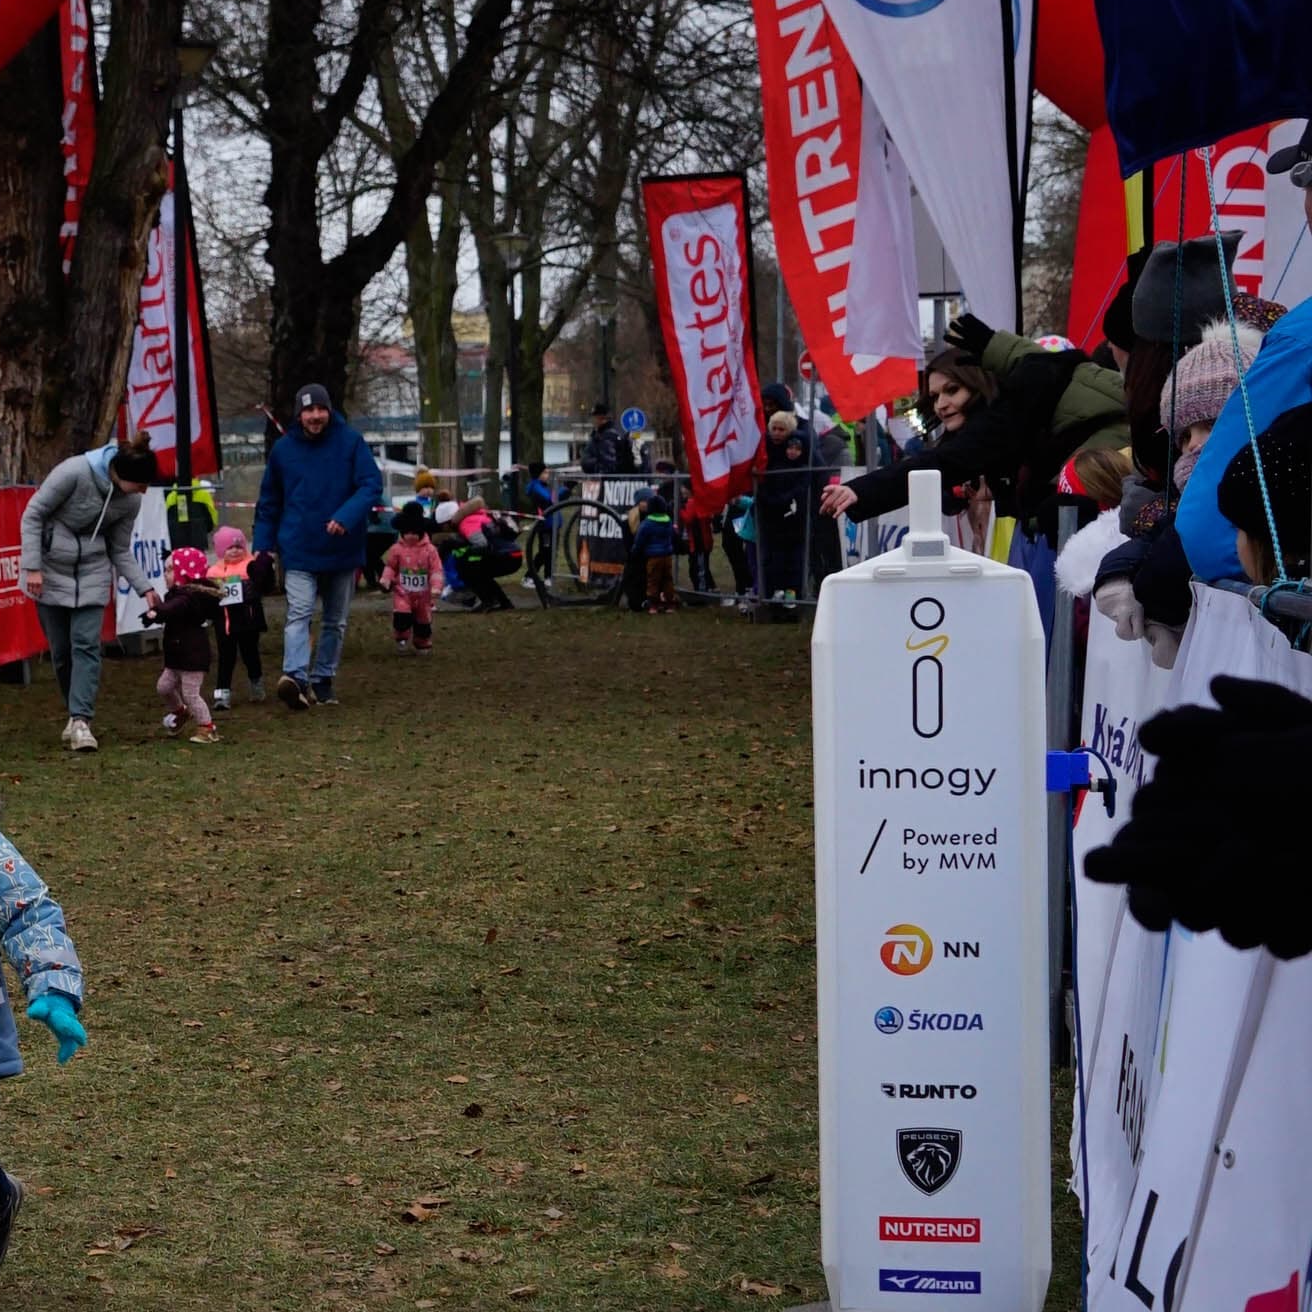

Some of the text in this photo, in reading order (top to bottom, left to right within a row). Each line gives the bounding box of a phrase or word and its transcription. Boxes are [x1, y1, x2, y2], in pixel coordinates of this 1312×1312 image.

[683, 233, 738, 457] Nartes
[858, 758, 997, 797] innogy
[902, 827, 998, 846] Powered
[902, 852, 997, 875] by MVM
[943, 941, 980, 958] NN
[907, 1008, 984, 1031] ŠKODA
[899, 1083, 978, 1100] RUNTO
[901, 1133, 956, 1142] PEUGEOT
[884, 1221, 976, 1238] NUTREND
